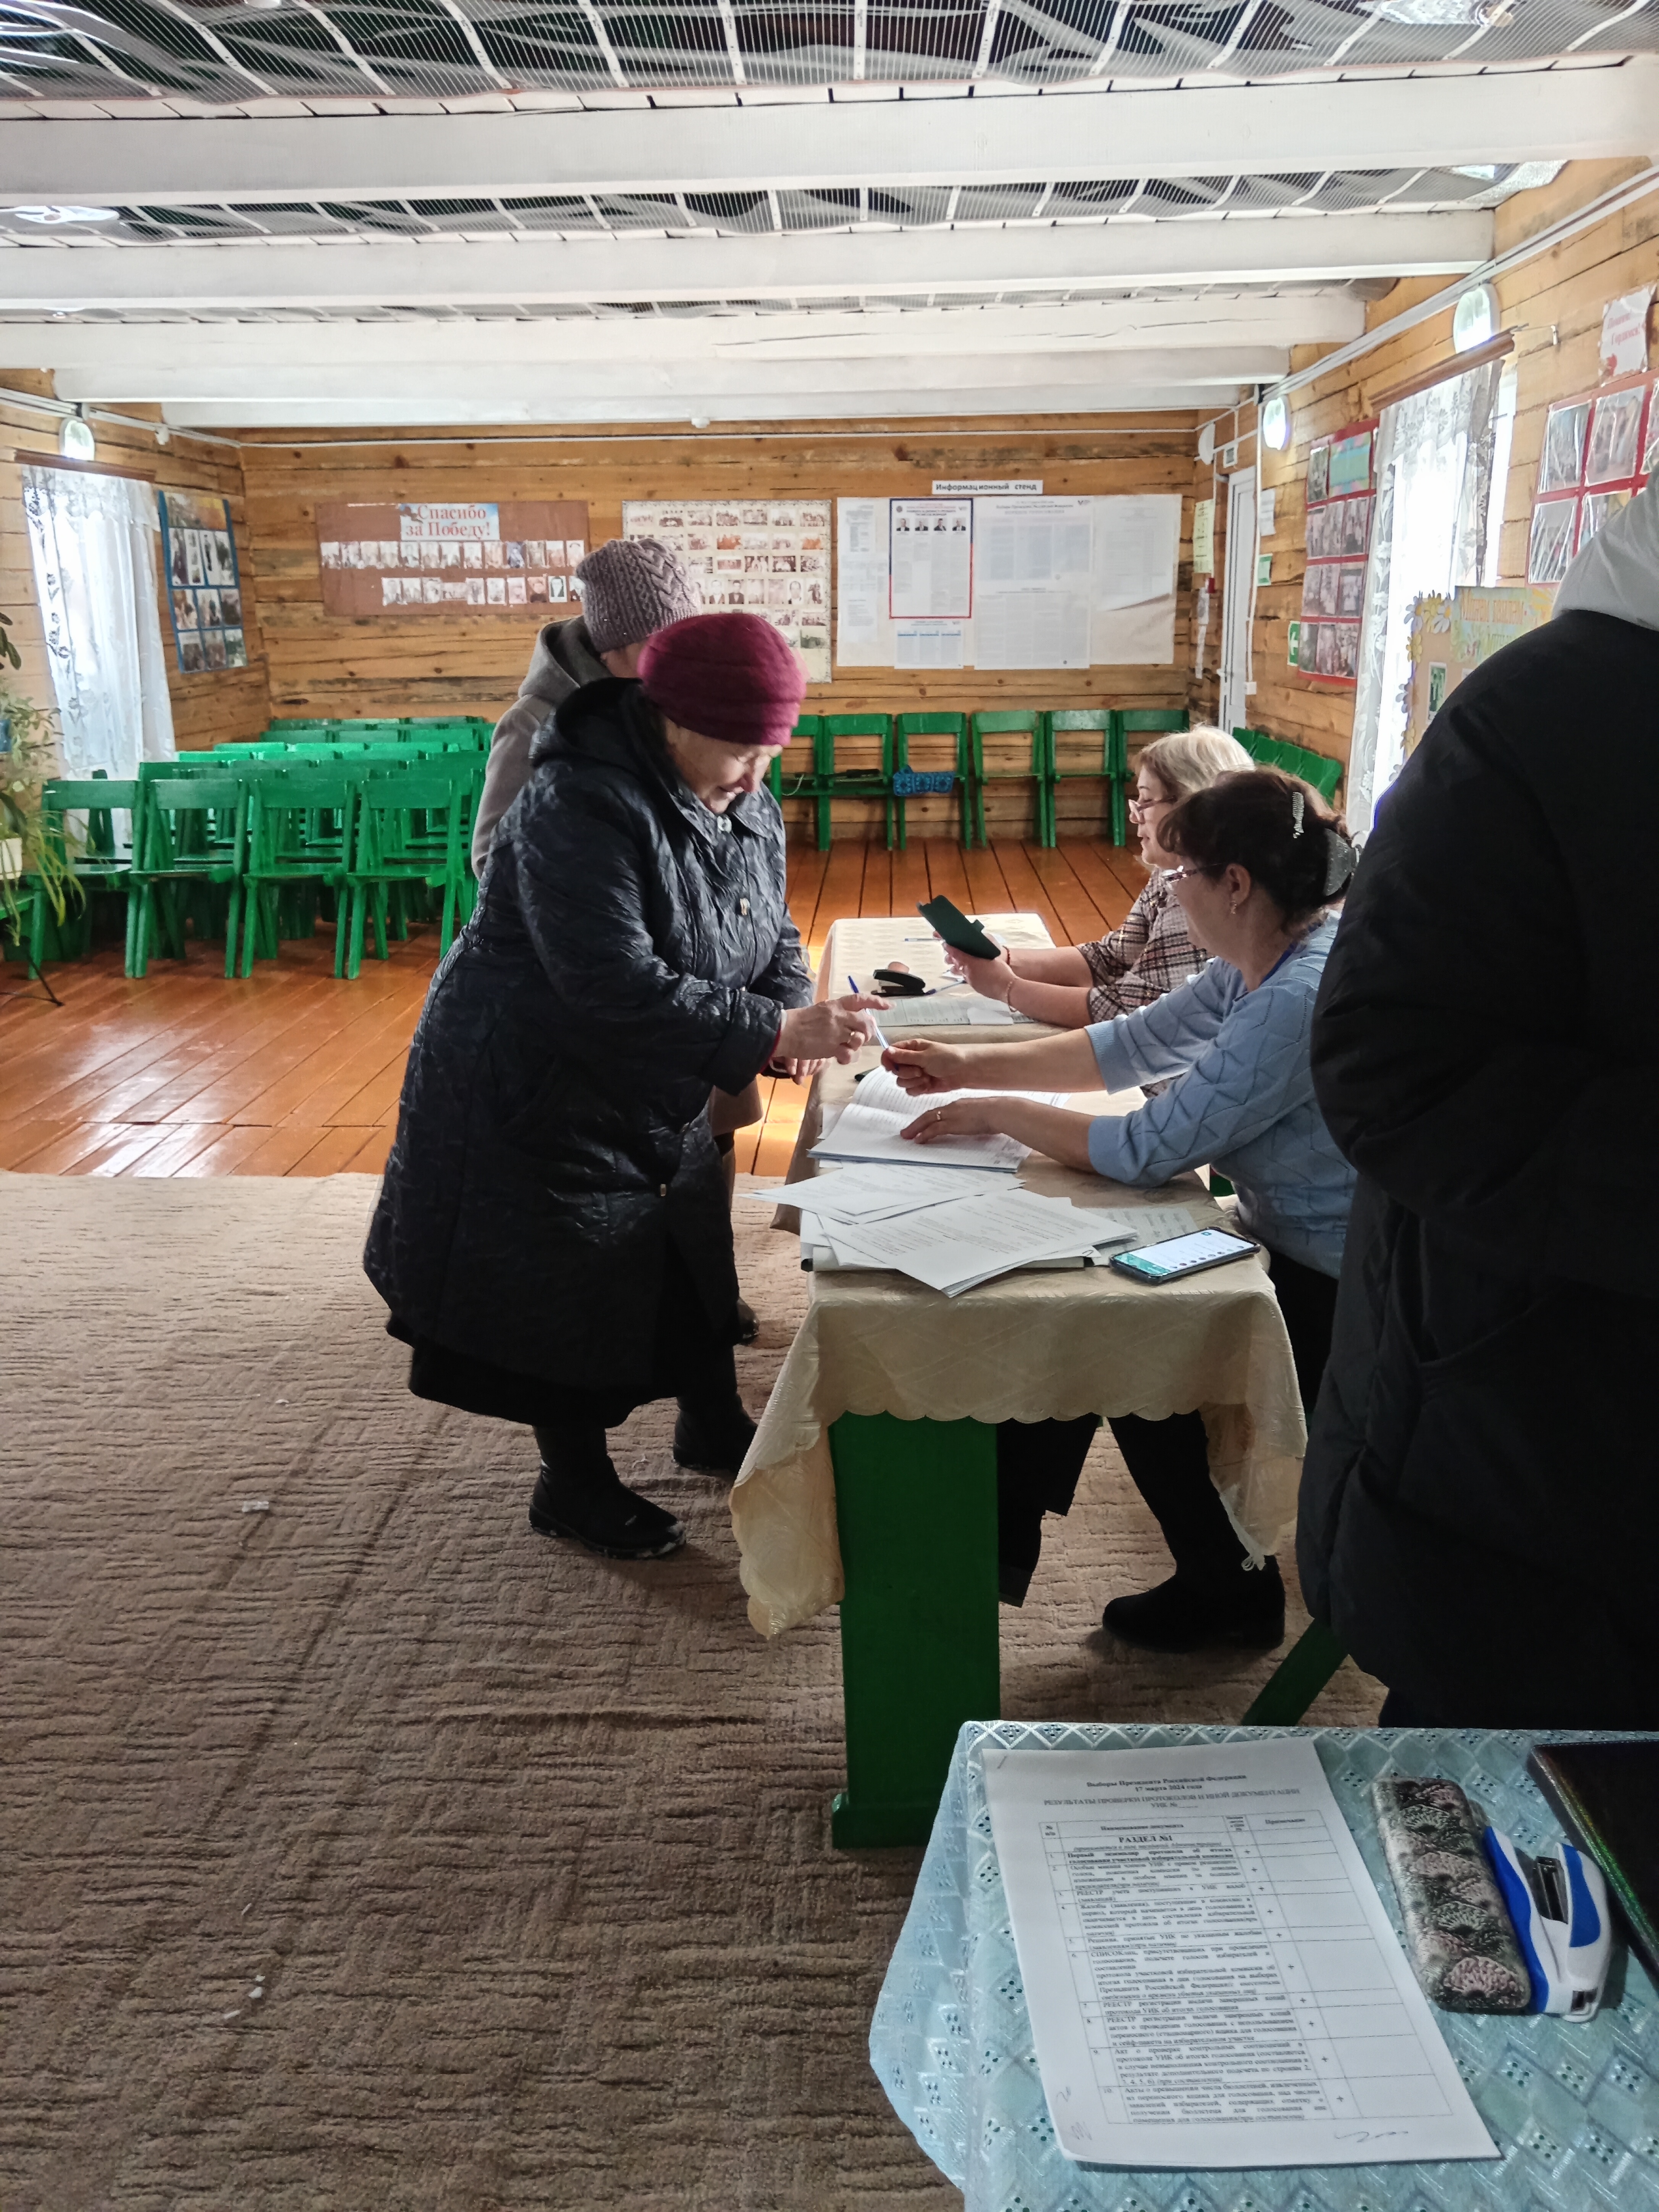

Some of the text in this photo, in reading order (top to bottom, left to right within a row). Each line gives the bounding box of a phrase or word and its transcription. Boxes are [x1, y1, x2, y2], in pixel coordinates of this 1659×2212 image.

[418, 505, 486, 519] Спасибо
[406, 521, 490, 541] за Победу!
[1232, 1788, 1300, 1797] ДОКУМЕНТАЦИИ
